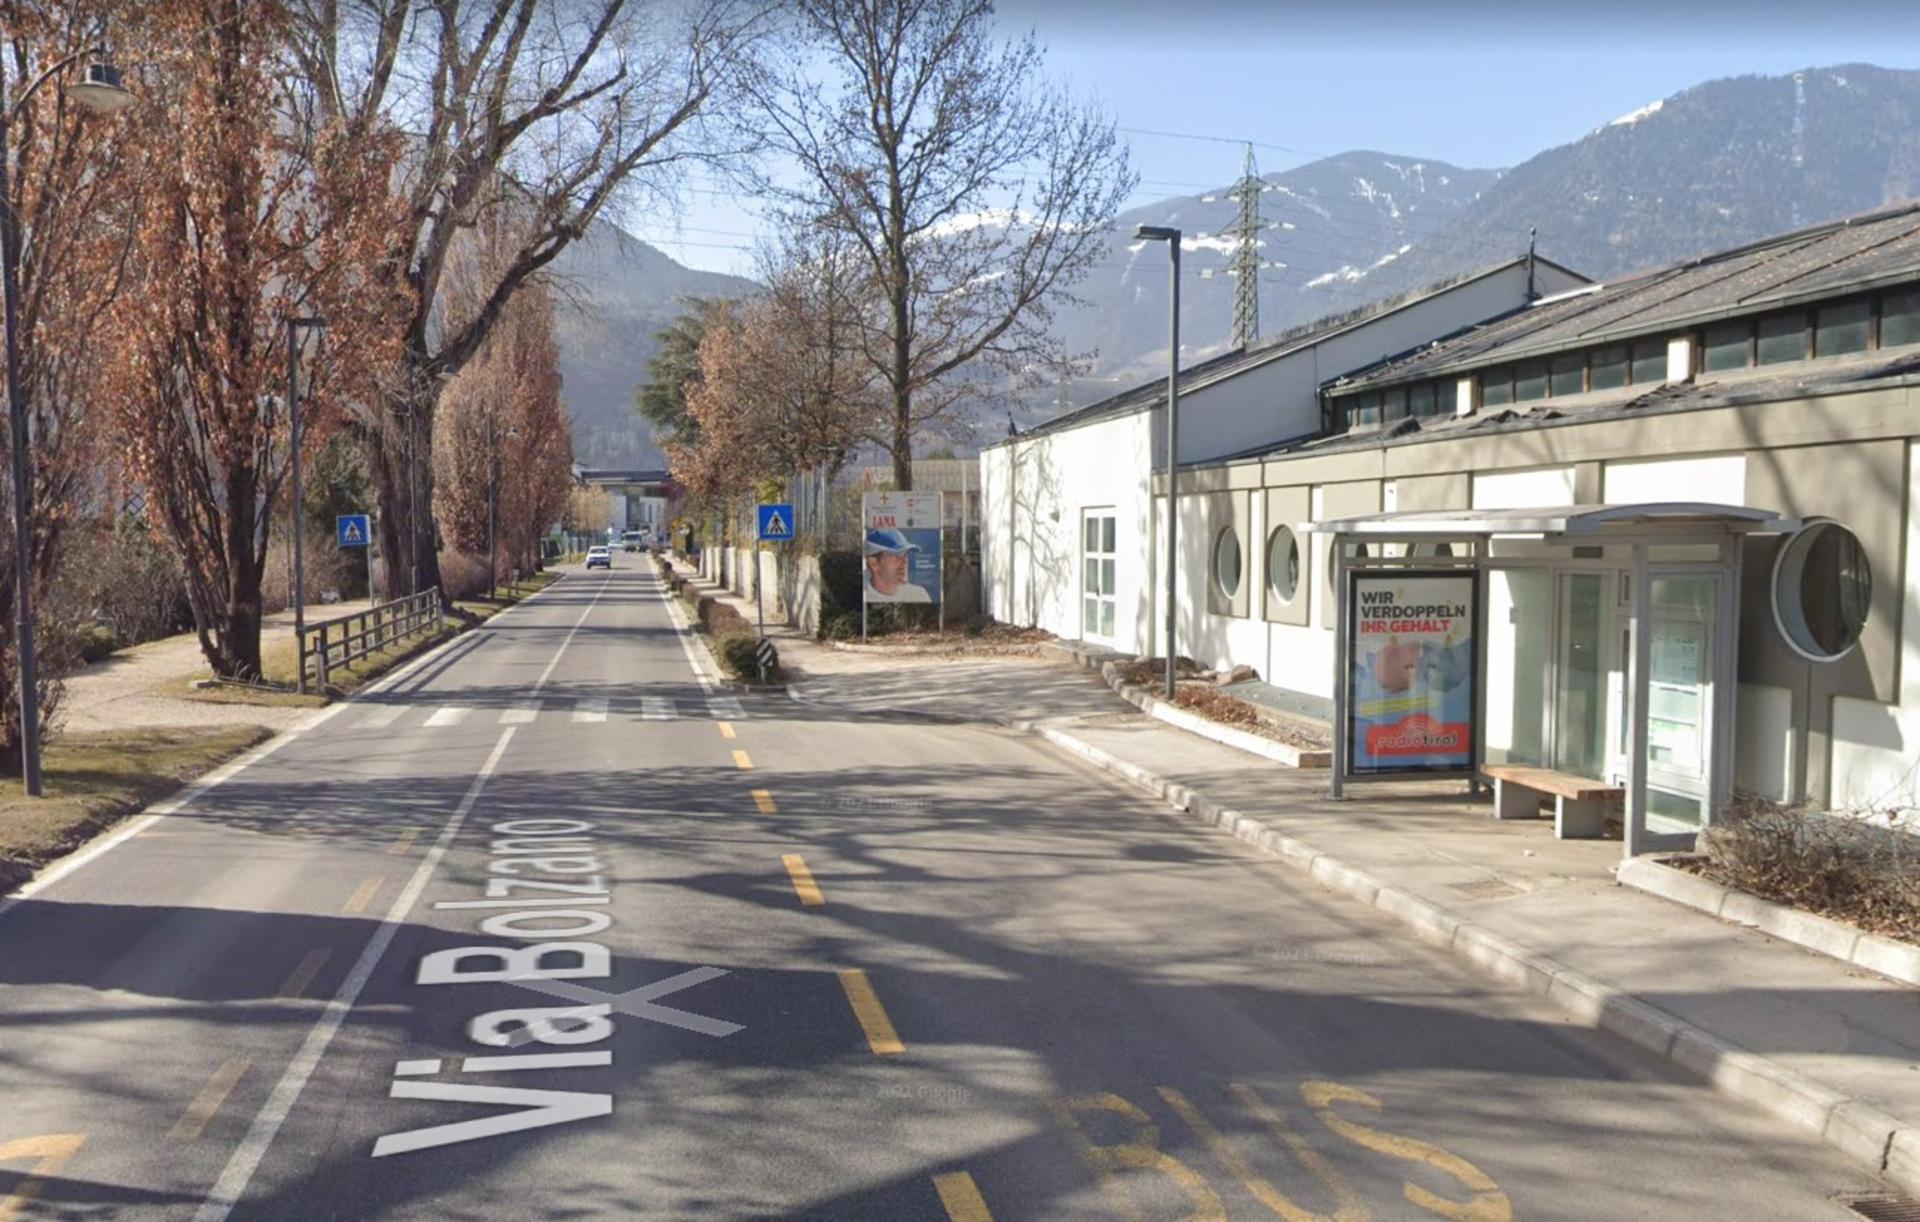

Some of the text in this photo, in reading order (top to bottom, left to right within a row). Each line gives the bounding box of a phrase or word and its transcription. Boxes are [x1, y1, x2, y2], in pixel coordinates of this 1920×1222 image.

[872, 515, 896, 528] LANA
[1361, 591, 1394, 604] WIR
[1361, 605, 1466, 619] VERDOPPELN
[1361, 619, 1450, 633] IHR GEHALT
[1050, 1078, 1514, 1222] BUS
